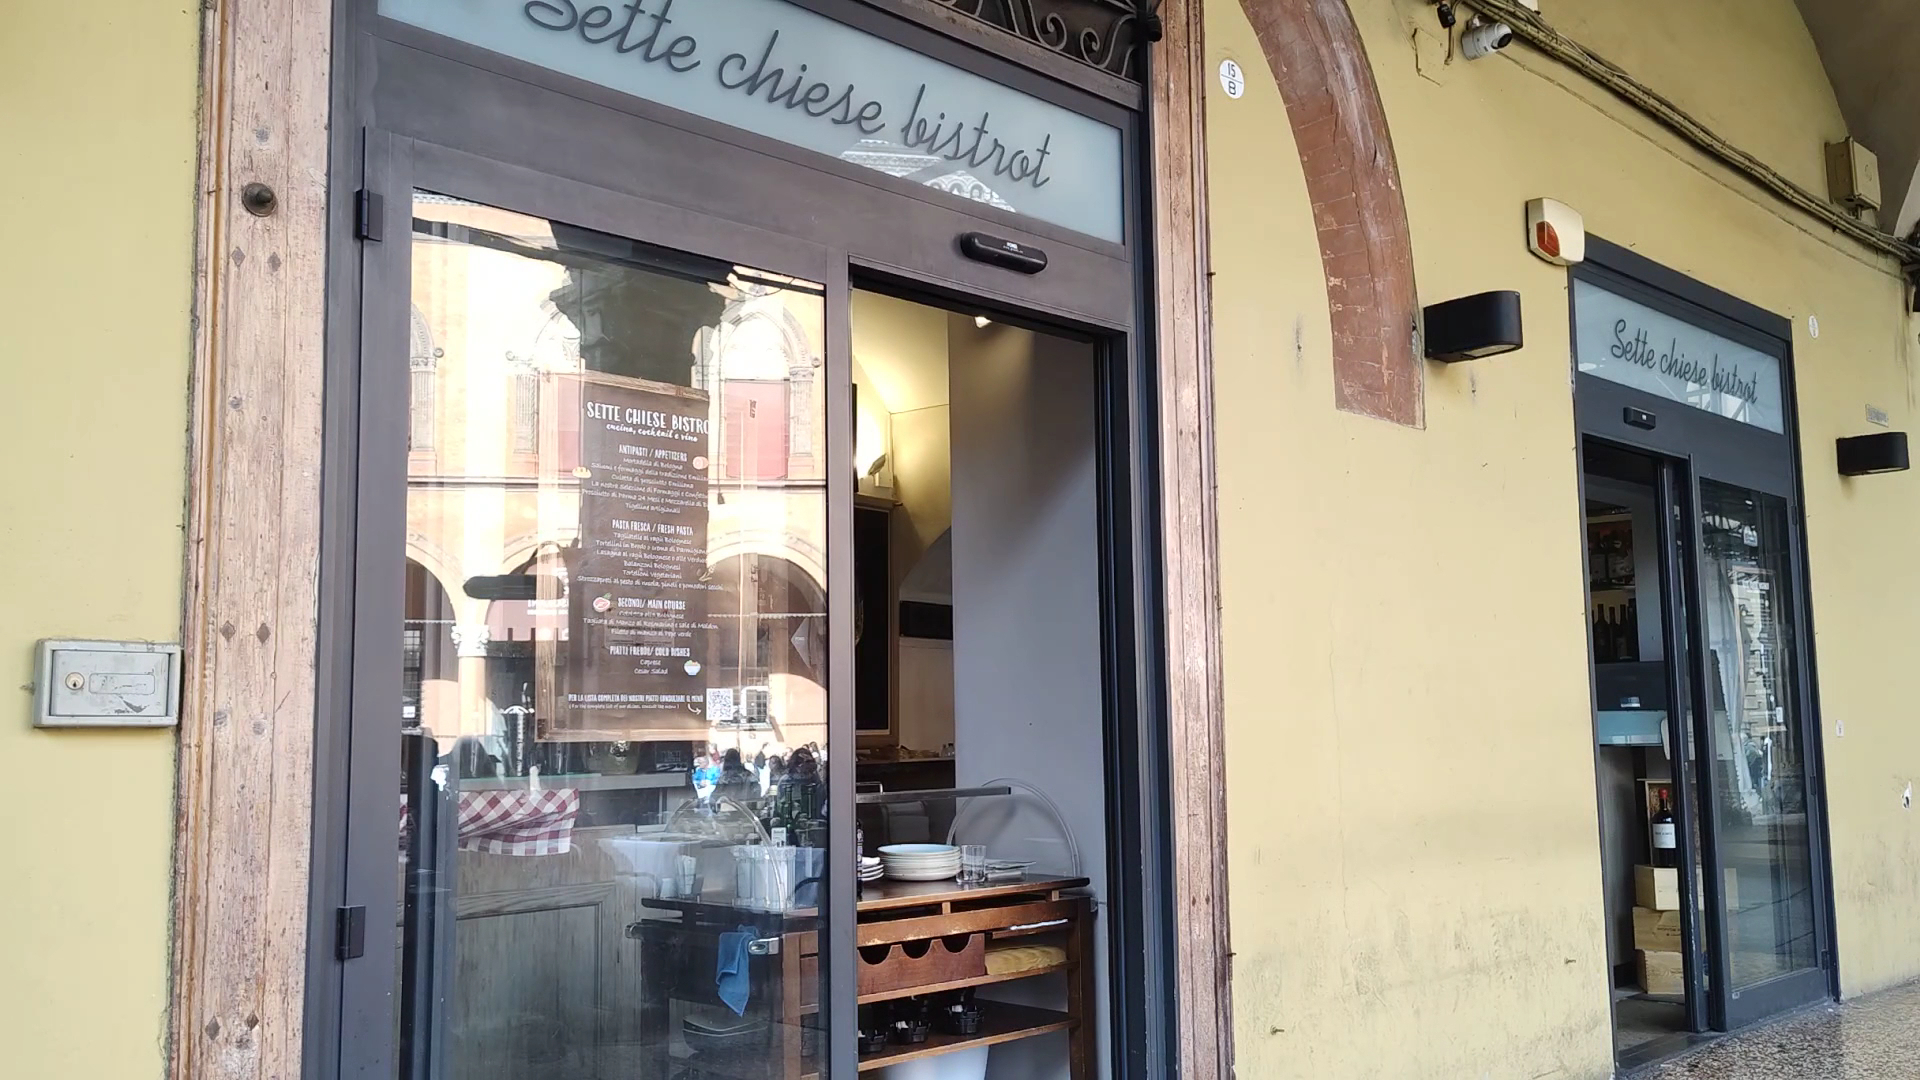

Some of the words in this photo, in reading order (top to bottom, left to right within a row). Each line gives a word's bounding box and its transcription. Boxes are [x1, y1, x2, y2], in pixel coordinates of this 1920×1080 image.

[1228, 62, 1236, 78] 15
[1228, 81, 1236, 95] B
[719, 30, 885, 134] chiese
[901, 83, 1050, 188] bistrot
[1610, 319, 1656, 369] Sette
[1660, 337, 1707, 386] chiese
[1711, 353, 1757, 403] bistrot
[586, 401, 620, 421] SETTE
[625, 408, 666, 428] CHIESE
[606, 423, 636, 434] cucina,
[638, 427, 672, 438] cocktail
[681, 432, 698, 442] vino
[619, 444, 648, 456] ANTIPASTI
[654, 449, 687, 462] APPETIZERS
[661, 461, 683, 470] Bologna
[618, 493, 636, 501] Parma
[612, 519, 630, 530] PASTA
[630, 521, 650, 532] FRESCA
[657, 524, 674, 534] FRESH
[676, 526, 693, 536] PASTA
[596, 540, 622, 548] Tortellini
[654, 562, 681, 571] Bolognesi
[622, 569, 649, 578] Tortelloni
[647, 599, 663, 610] MAIN
[664, 600, 686, 610] COURSE
[610, 645, 628, 655] PIATTI
[655, 647, 669, 657] COLD
[671, 648, 690, 657] DISHES
[568, 694, 578, 702] PER
